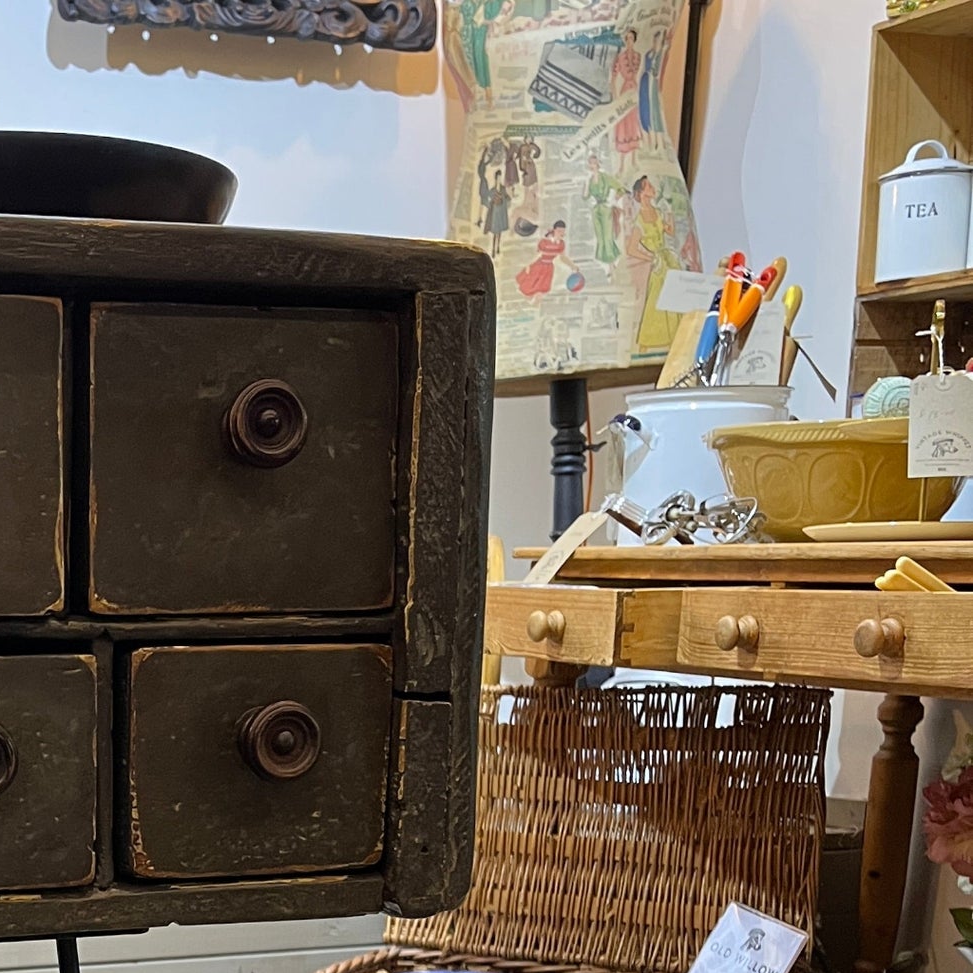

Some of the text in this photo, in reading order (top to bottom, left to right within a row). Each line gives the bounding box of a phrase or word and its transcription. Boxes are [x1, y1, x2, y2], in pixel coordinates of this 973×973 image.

[905, 202, 939, 219] TEA
[915, 430, 942, 450] VINTAGE
[710, 942, 732, 958] OLD
